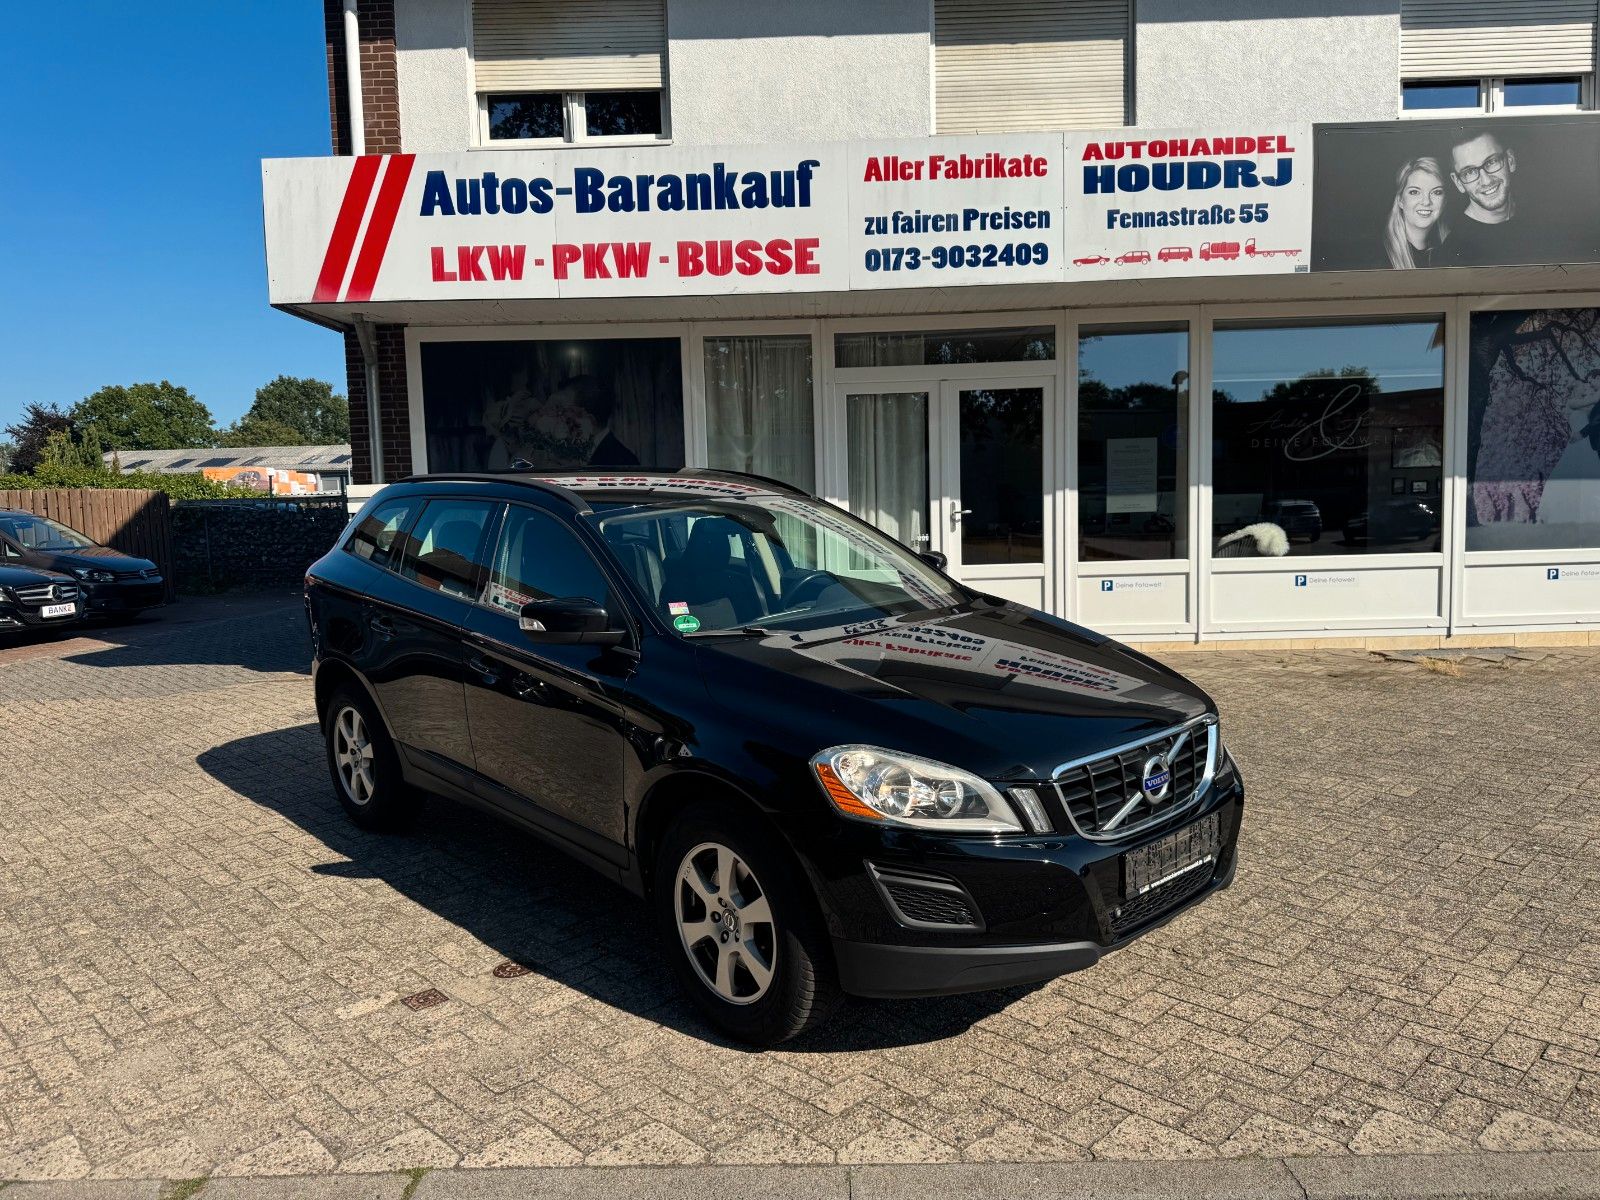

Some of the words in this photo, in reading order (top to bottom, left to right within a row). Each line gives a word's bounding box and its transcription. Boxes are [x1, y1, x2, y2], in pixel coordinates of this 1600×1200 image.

[1082, 135, 1295, 161] AUTOHANDEL
[864, 154, 924, 182] Aller
[929, 153, 1048, 181] Fabrikate
[420, 160, 821, 217] Autos-Barankauf
[864, 215, 888, 236] zu
[892, 209, 959, 234] fairen
[963, 208, 1051, 232] Preisen
[1107, 204, 1236, 230] Fennastraße
[1239, 203, 1269, 224] 55
[431, 244, 527, 283] LKW
[552, 241, 652, 281] PKW
[677, 237, 821, 278] BUSSE
[865, 243, 1049, 272] 0173-9032409
[1146, 773, 1169, 787] VOLVO
